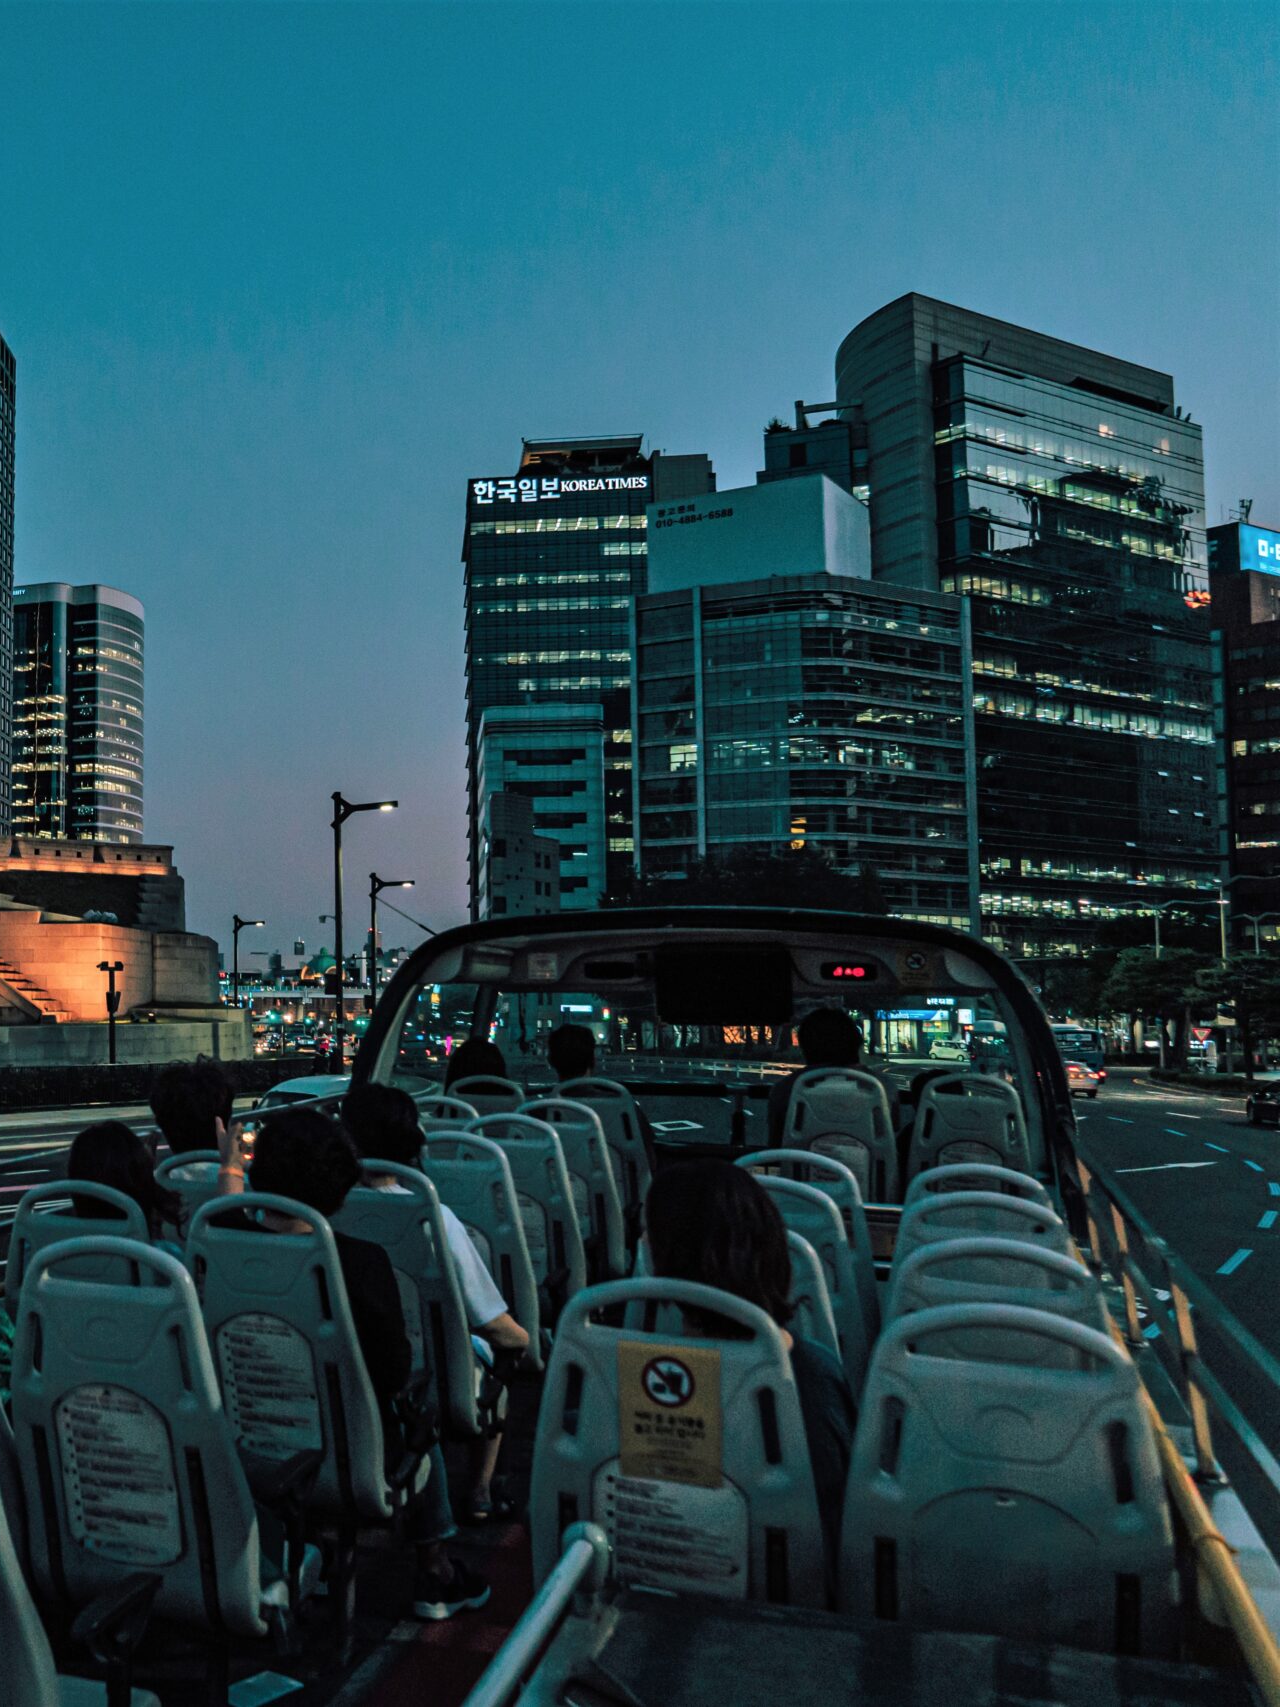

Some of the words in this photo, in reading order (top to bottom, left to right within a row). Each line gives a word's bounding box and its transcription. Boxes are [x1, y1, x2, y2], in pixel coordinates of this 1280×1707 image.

[473, 478, 560, 504] 한국일보
[561, 478, 605, 492] KOREA
[606, 476, 647, 490] TIMES
